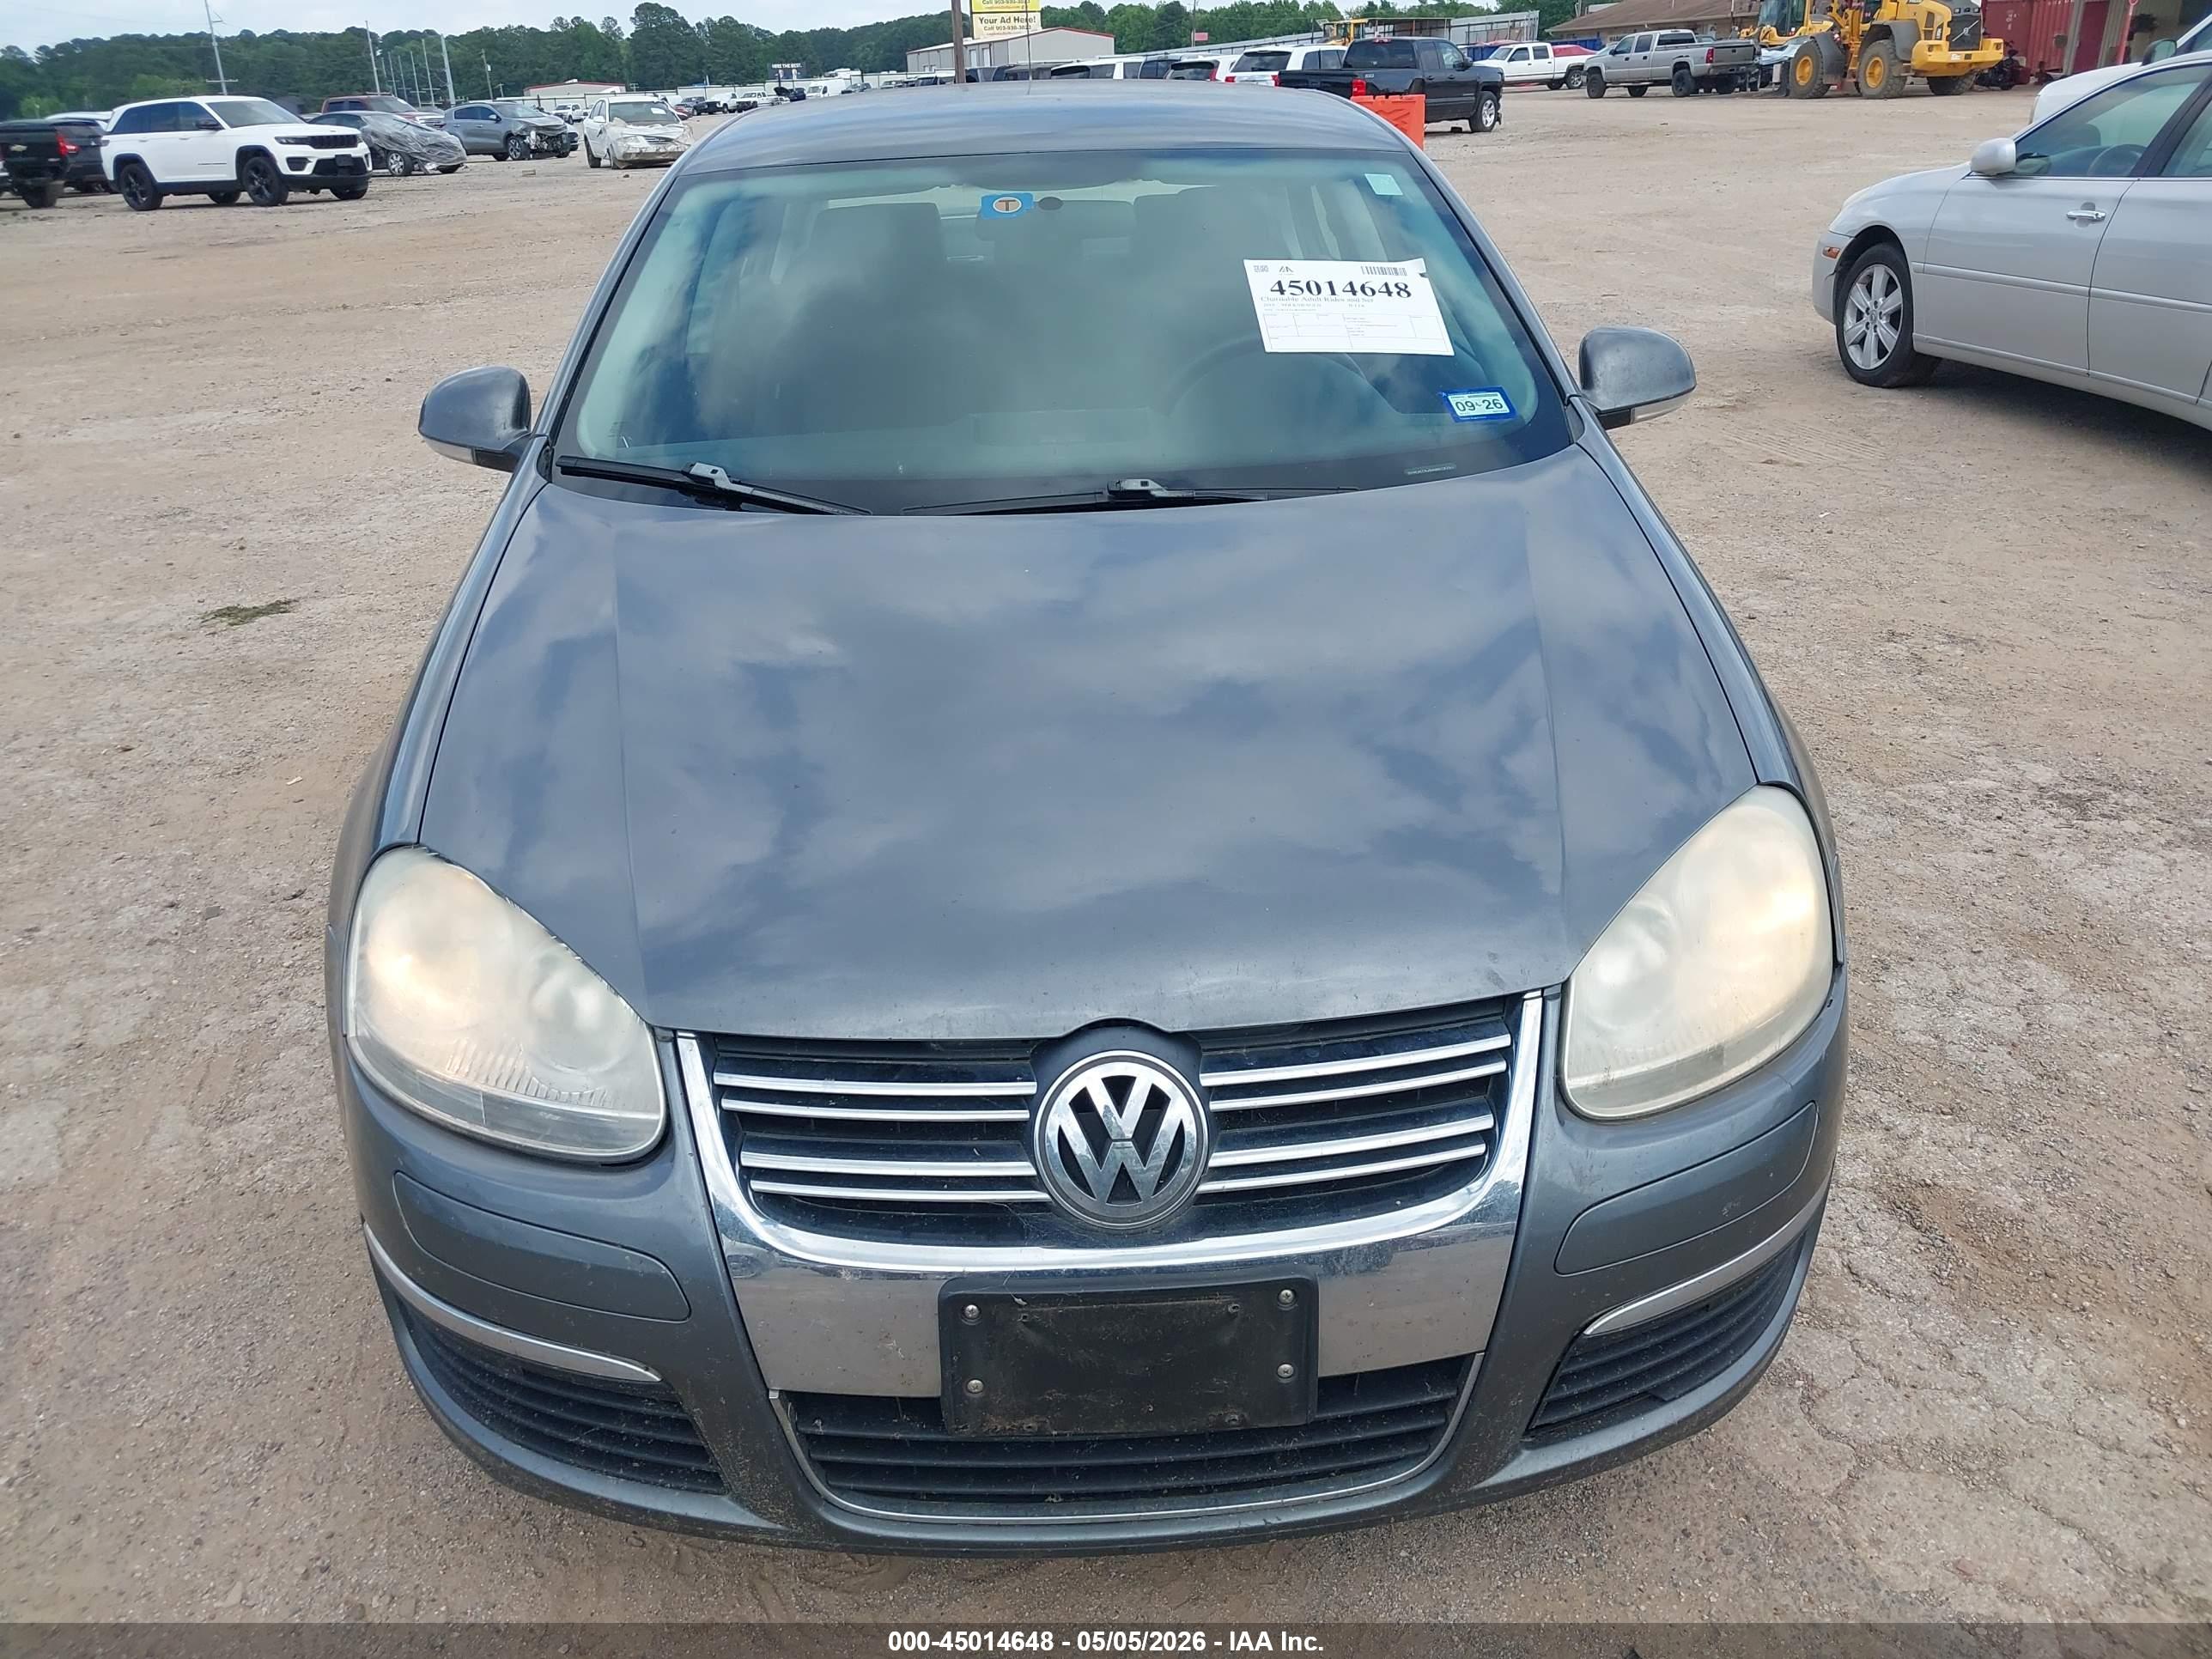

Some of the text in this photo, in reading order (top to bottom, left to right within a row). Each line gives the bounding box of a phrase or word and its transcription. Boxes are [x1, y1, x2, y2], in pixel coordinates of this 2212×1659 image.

[1270, 280, 1413, 298] 45014648
[1455, 398, 1504, 412] 09 26
[1045, 1061, 1198, 1218] VW
